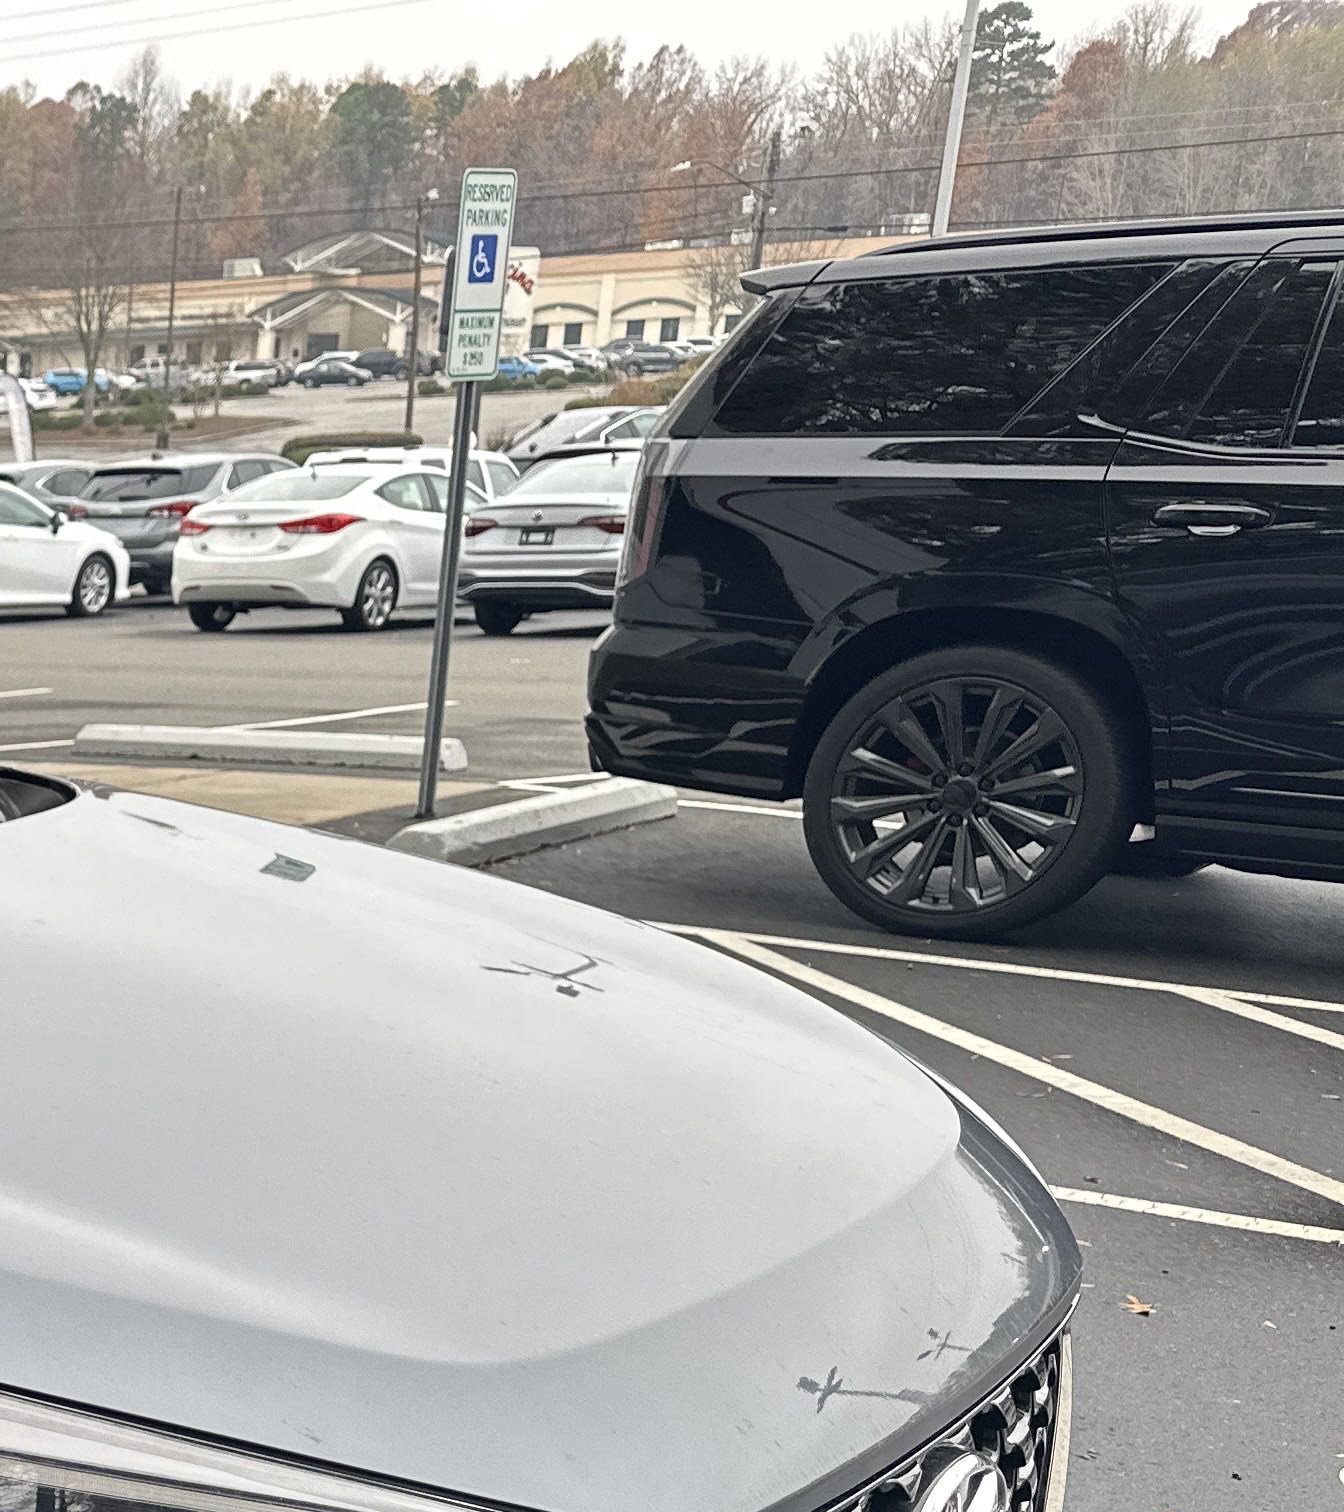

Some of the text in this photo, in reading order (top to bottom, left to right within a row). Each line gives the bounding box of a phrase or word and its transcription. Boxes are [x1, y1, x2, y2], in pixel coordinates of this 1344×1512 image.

[465, 183, 513, 203] RESERVED
[465, 208, 508, 228] PARKING
[458, 315, 495, 330] MAXIMUM
[457, 333, 492, 348] PENALTY
[462, 351, 484, 367] $250
